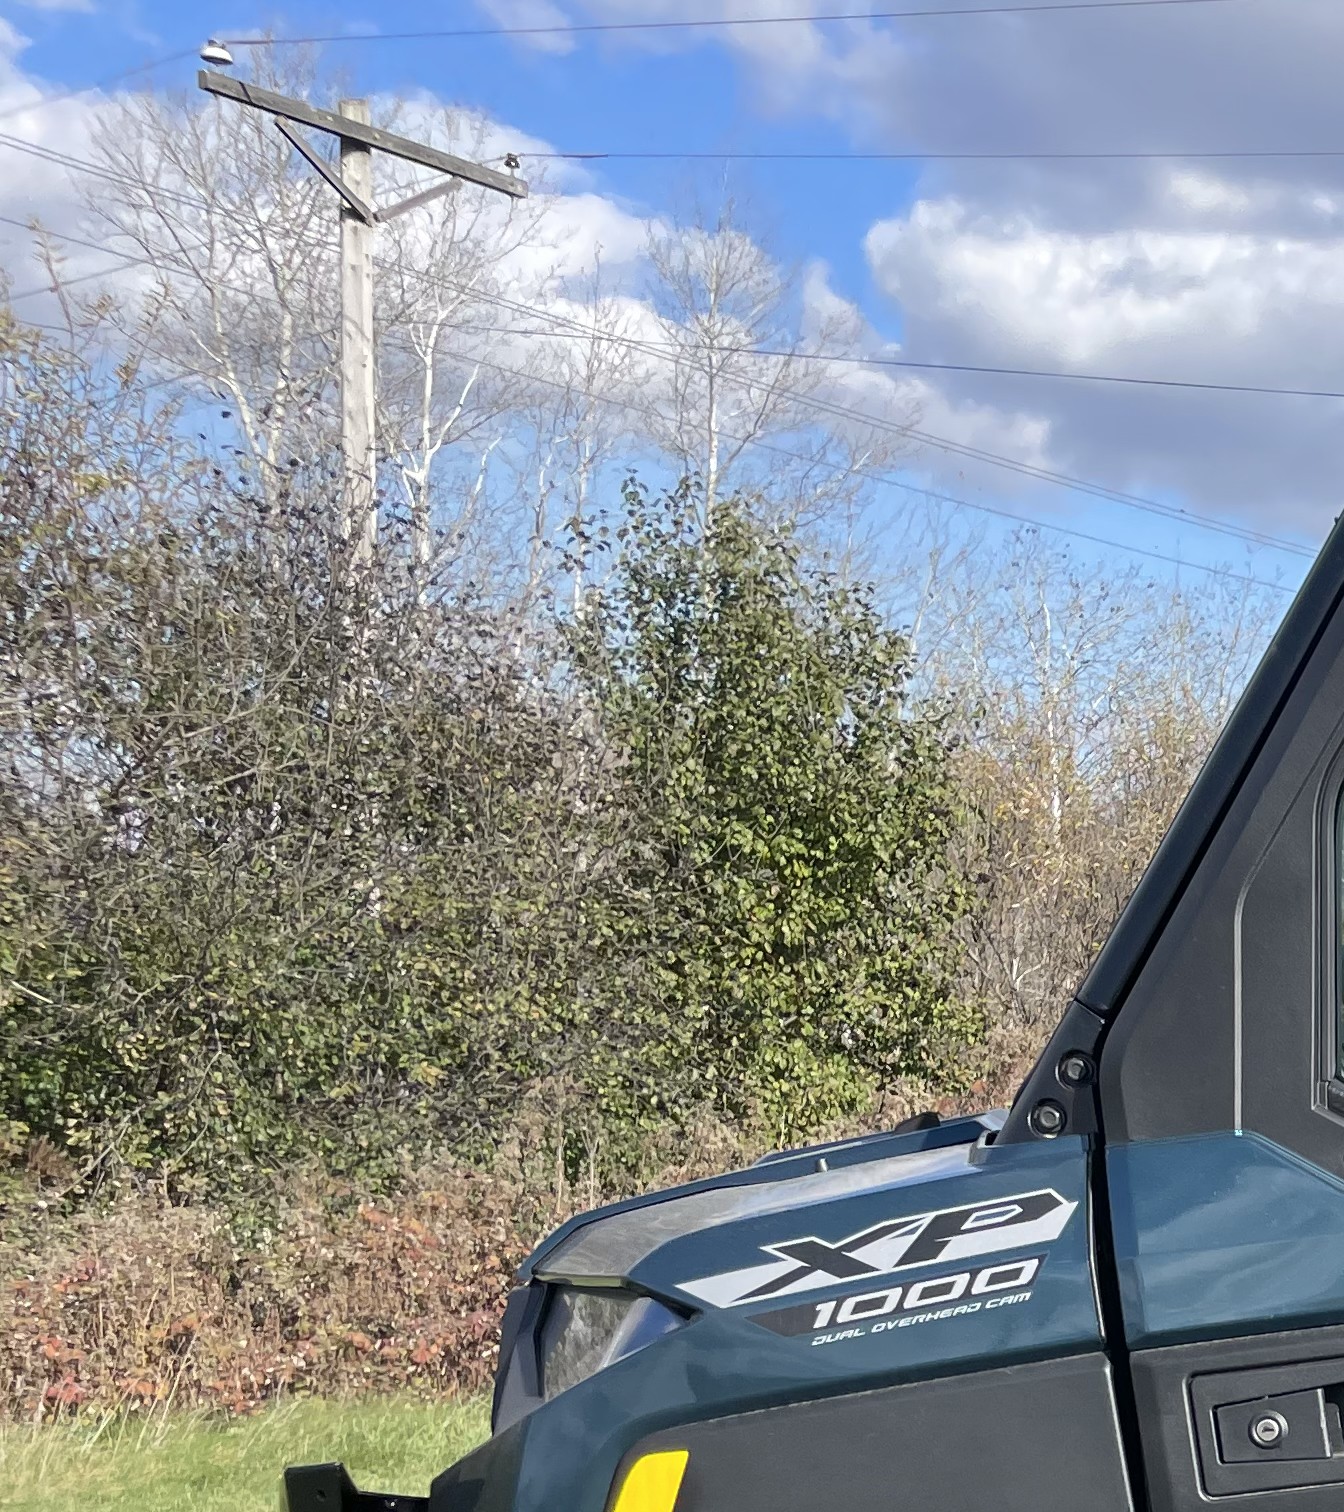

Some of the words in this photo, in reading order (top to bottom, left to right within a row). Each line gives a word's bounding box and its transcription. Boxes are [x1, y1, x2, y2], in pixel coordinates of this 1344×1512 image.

[731, 1191, 1066, 1303] XP
[811, 1327, 866, 1347] DUAL
[871, 1302, 982, 1334] OVERHEAD
[985, 1291, 1033, 1310] CAM
[813, 1258, 1041, 1330] 1000
